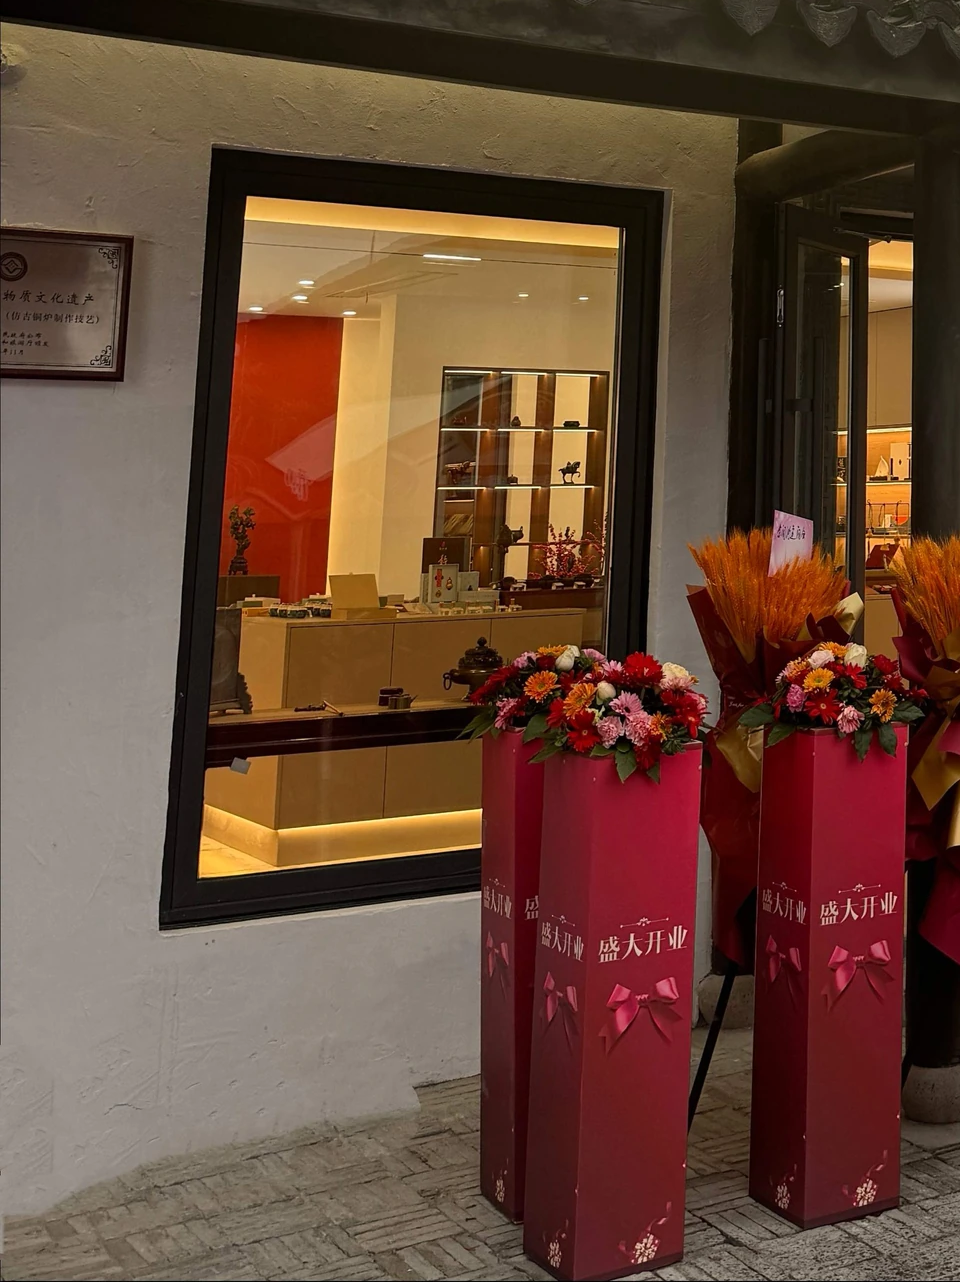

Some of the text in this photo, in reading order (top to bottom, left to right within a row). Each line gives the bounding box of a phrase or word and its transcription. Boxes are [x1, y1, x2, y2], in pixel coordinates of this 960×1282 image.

[483, 885, 512, 919] 盛大开业
[762, 889, 807, 925] 盛大开业
[820, 891, 898, 926] 盛大开业
[541, 922, 584, 962] 盛大开业
[598, 925, 688, 963] 盛大开业
